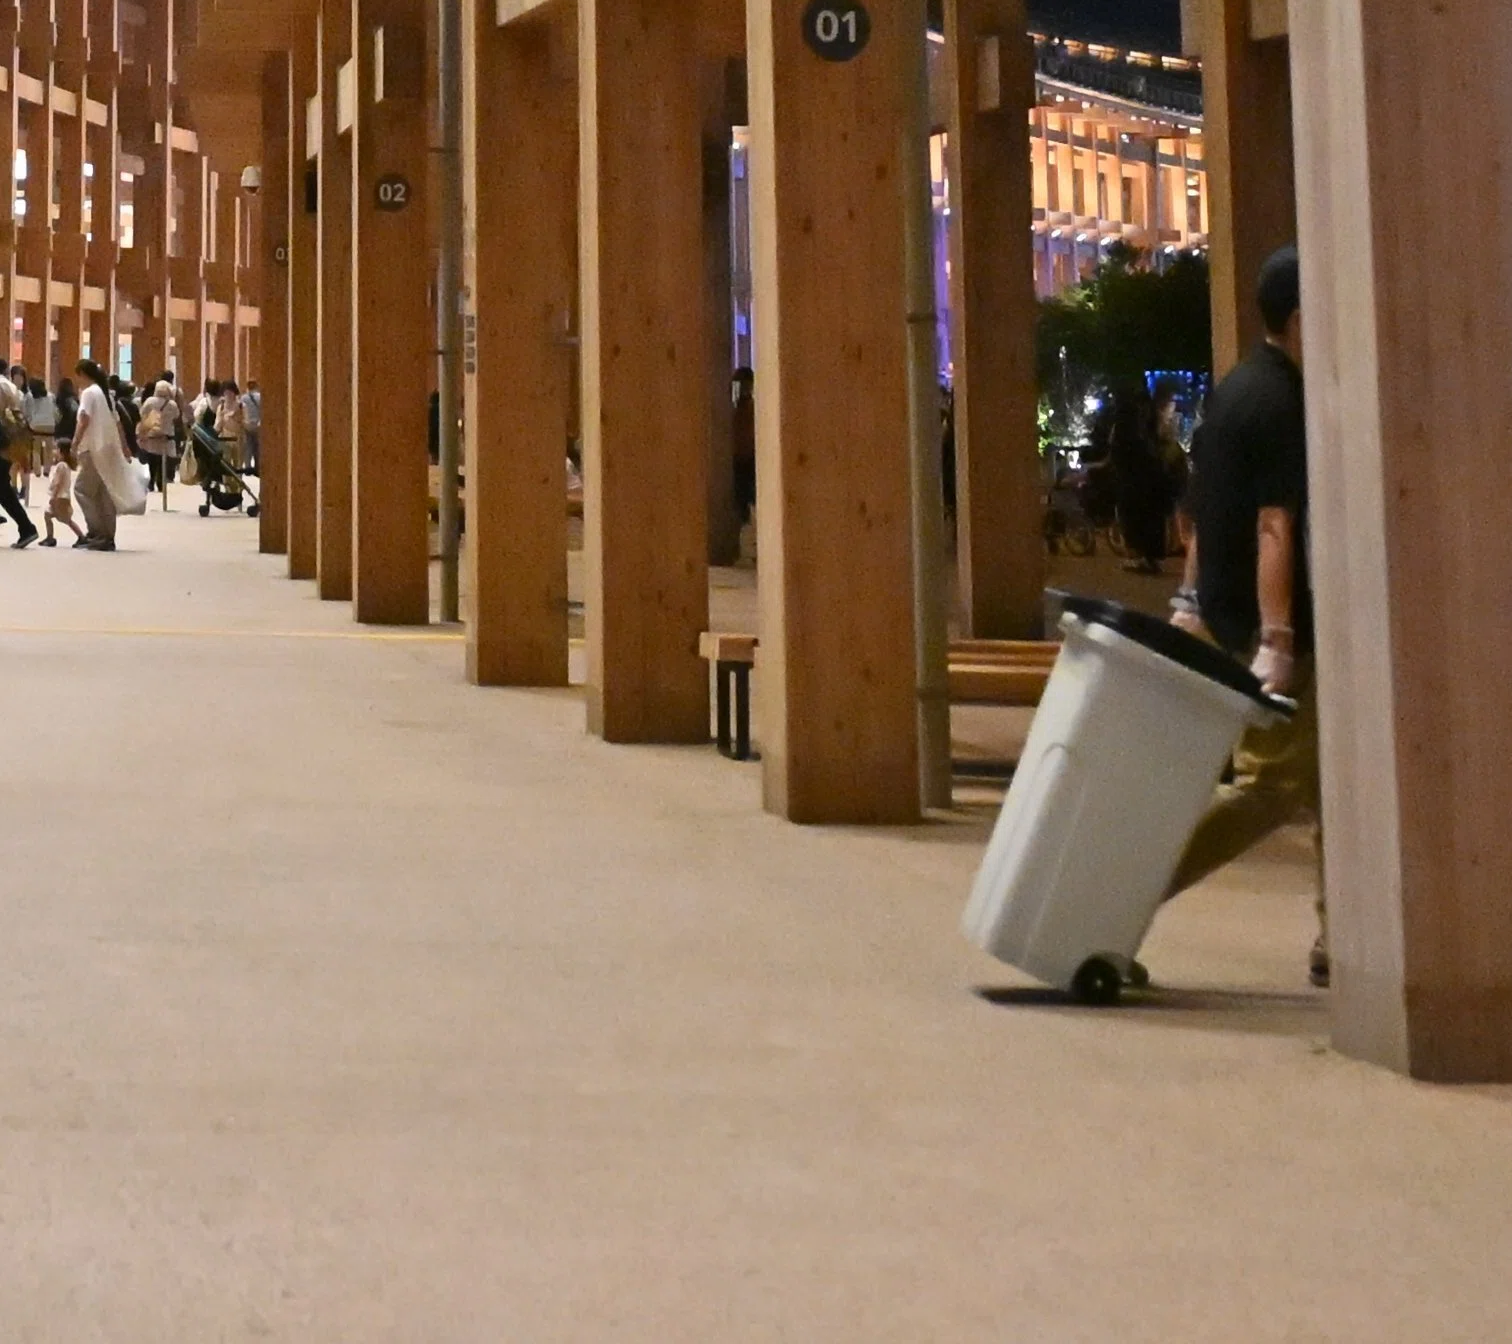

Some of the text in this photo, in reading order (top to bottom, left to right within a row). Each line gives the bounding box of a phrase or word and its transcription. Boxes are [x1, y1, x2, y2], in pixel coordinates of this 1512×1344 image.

[816, 9, 856, 43] 01
[379, 183, 406, 202] 02
[275, 247, 290, 261] 0
